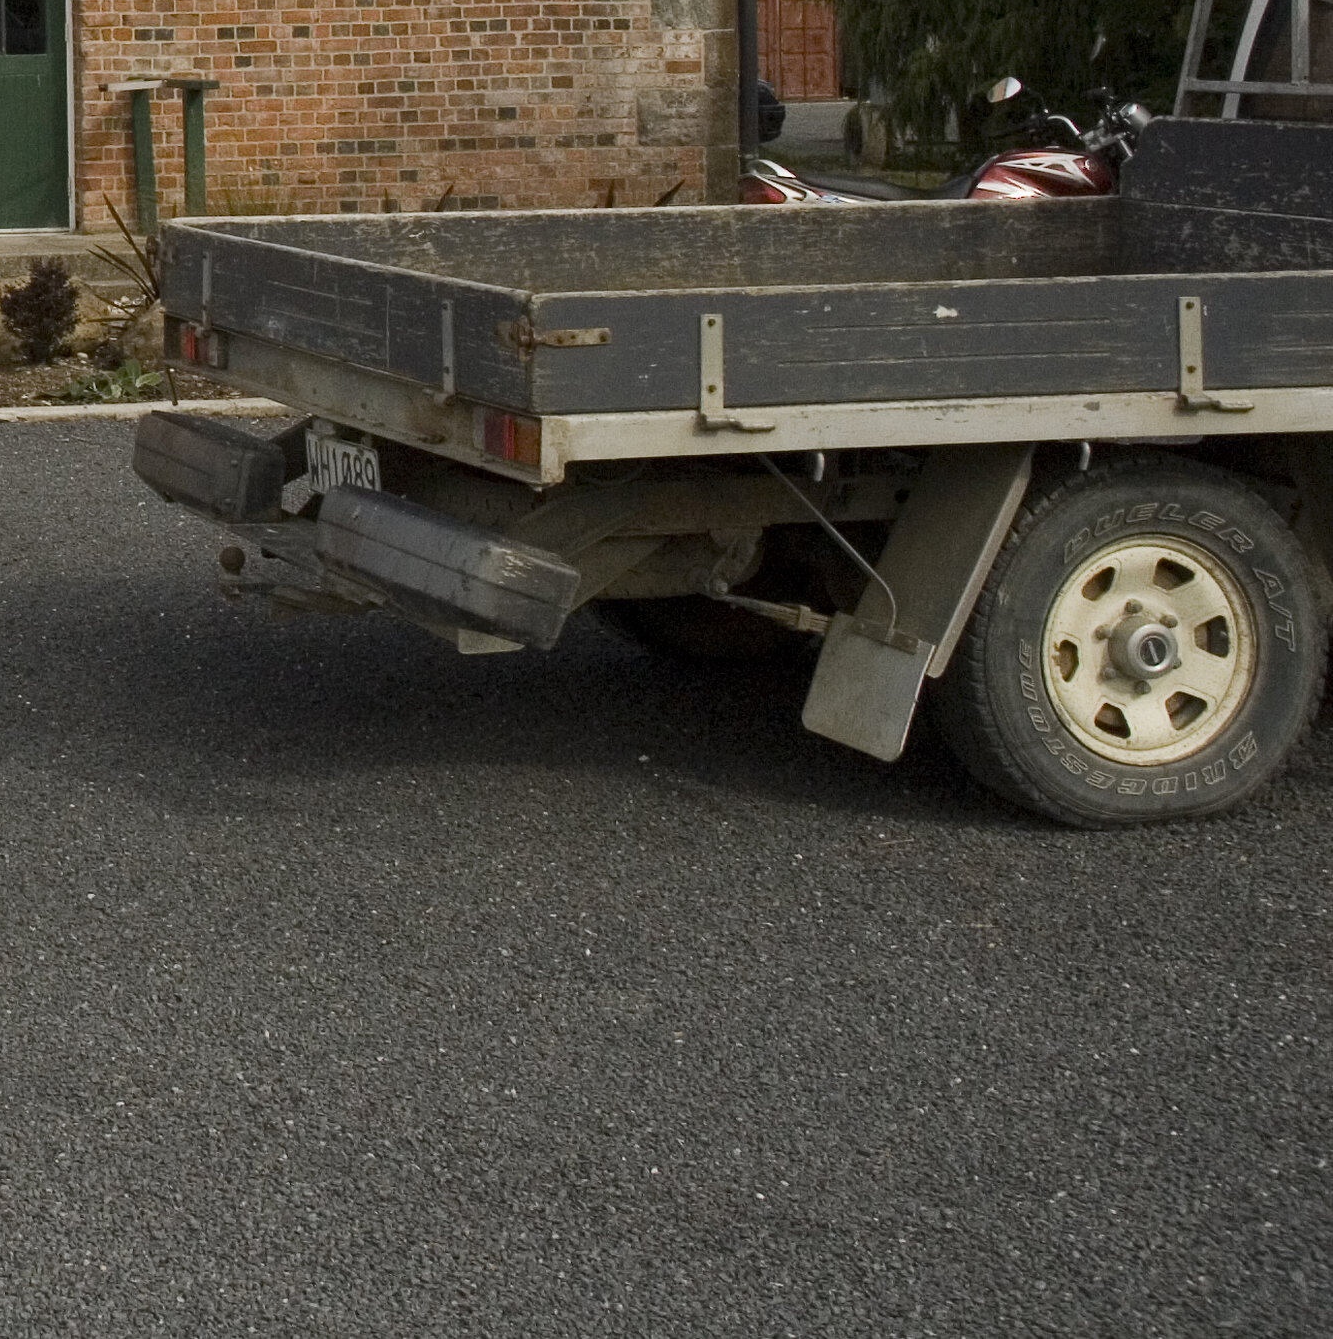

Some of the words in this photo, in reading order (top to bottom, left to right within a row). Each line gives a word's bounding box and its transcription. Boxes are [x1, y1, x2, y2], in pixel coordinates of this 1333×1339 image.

[1064, 502, 1255, 564] DUELER
[1252, 566, 1297, 653] A/T
[1018, 638, 1258, 796] BRIDGESTONE
